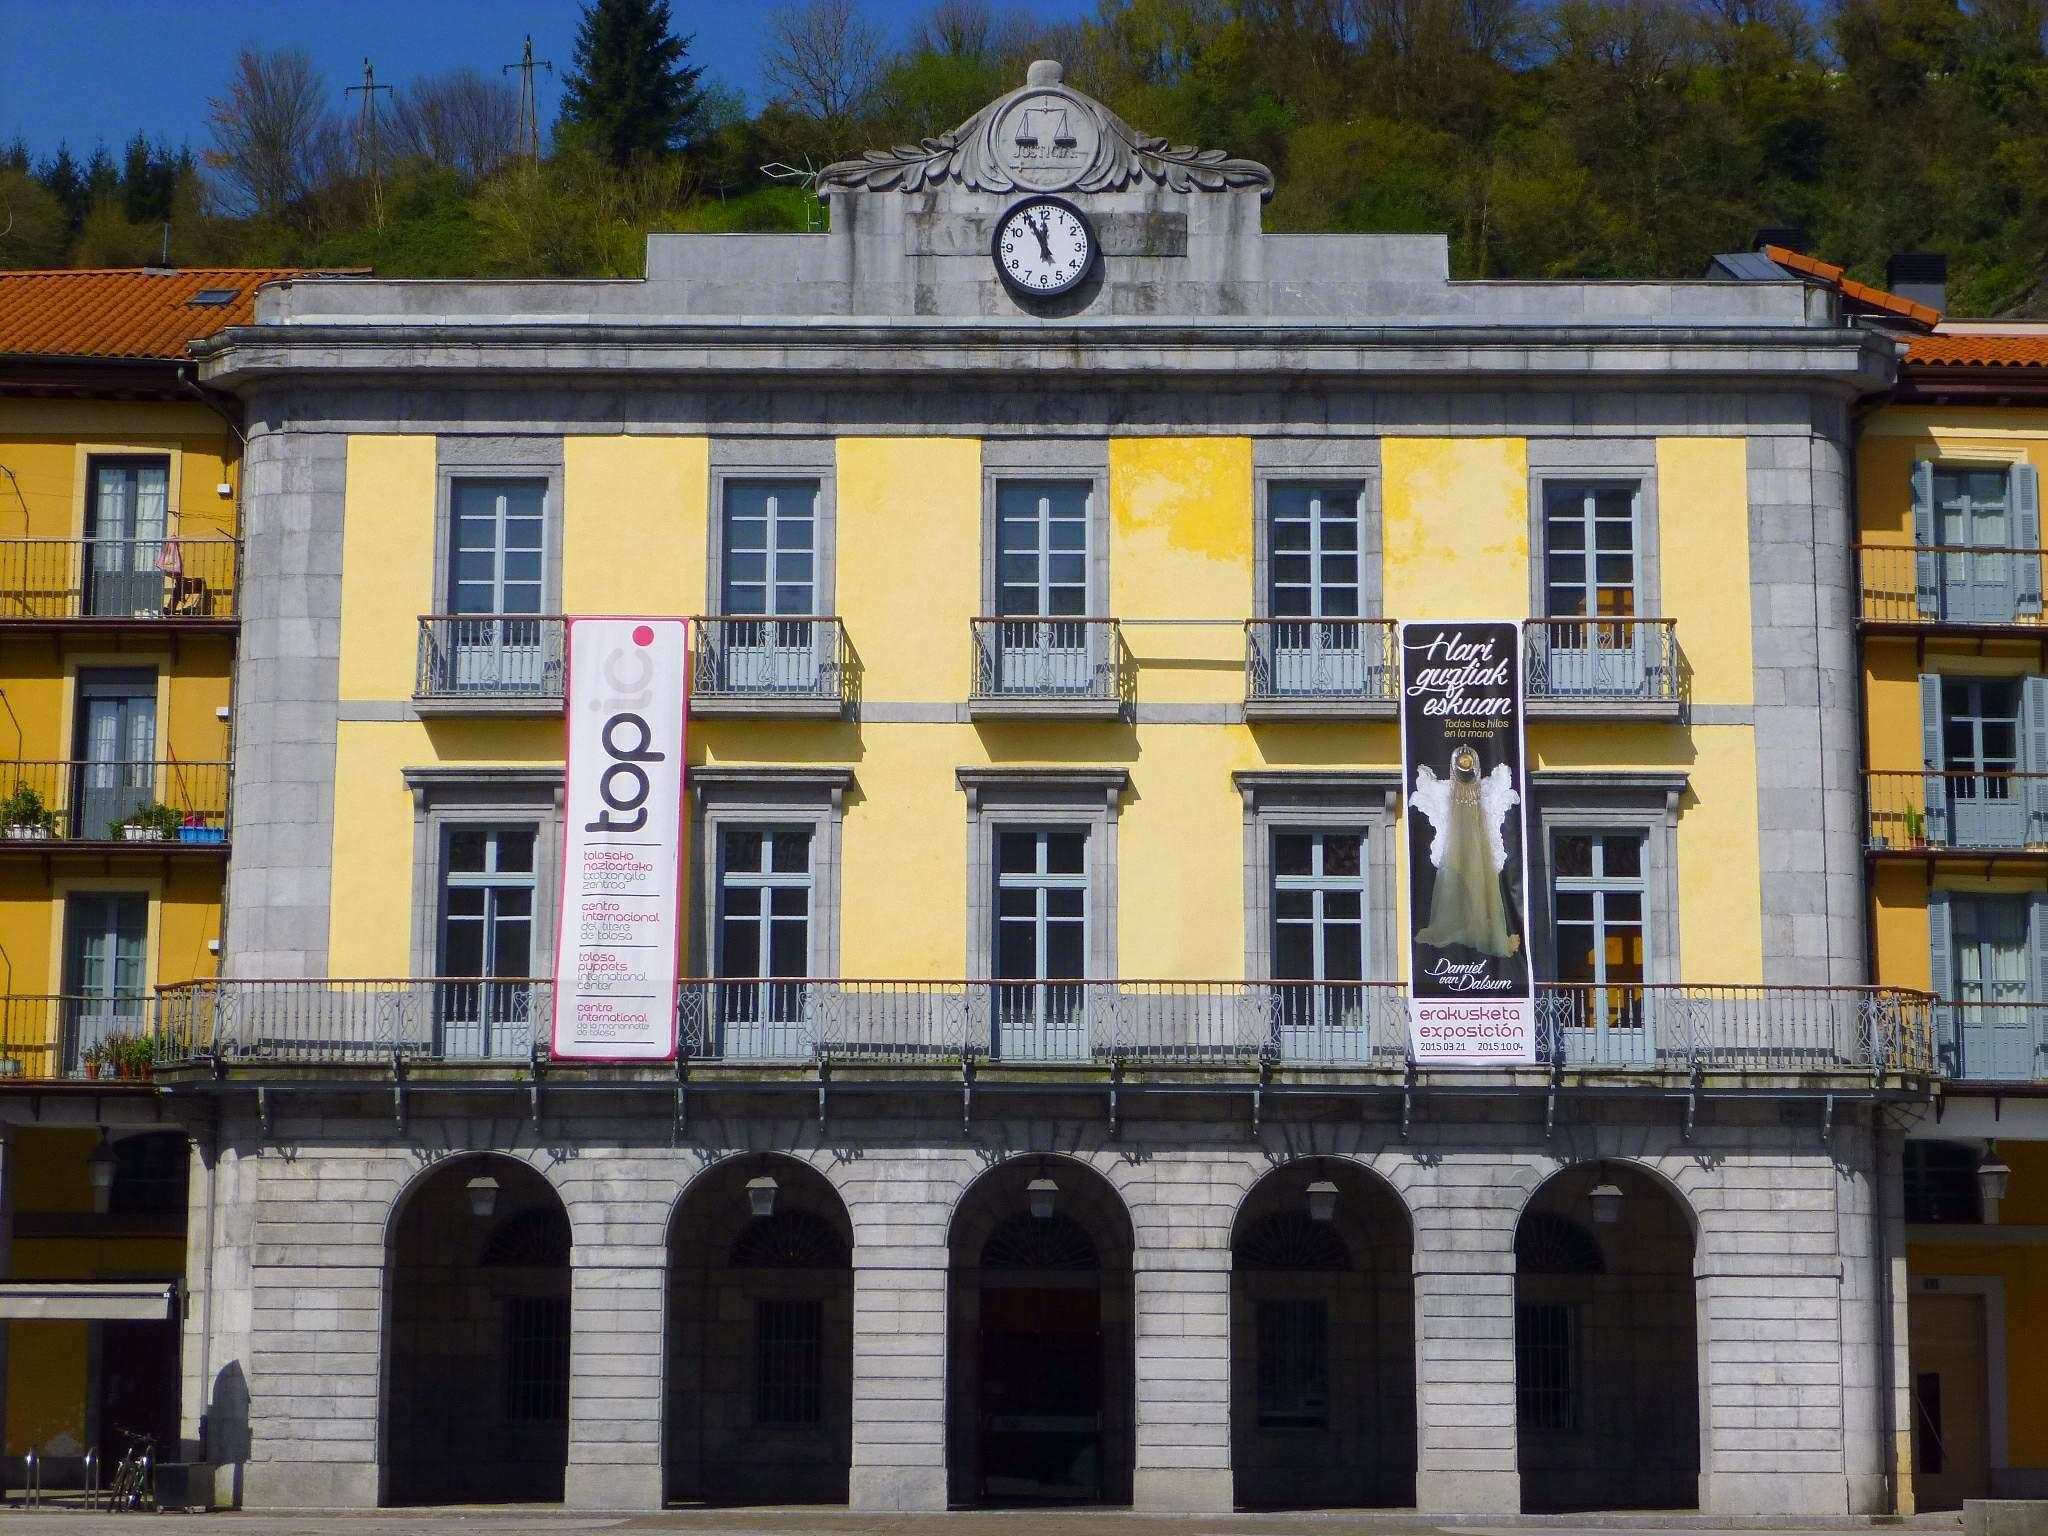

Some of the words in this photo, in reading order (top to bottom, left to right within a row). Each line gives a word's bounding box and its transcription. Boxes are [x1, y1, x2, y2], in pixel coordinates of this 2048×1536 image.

[1039, 210, 1051, 220] 12
[1058, 215, 1064, 225] 1
[1011, 228, 1023, 238] 10
[1070, 226, 1077, 236] 2
[1005, 243, 1014, 253] 9
[1074, 242, 1082, 253] 3
[1011, 259, 1020, 269] 8
[1069, 259, 1077, 269] 4
[1025, 270, 1033, 280] 7
[1040, 274, 1048, 285] 6
[1055, 271, 1063, 281] 5
[1403, 632, 1496, 661] Hari
[1407, 658, 1509, 698] guztiak
[1423, 688, 1512, 716] eskuan
[1444, 719, 1470, 728] Todos
[1472, 719, 1486, 728] los
[1487, 719, 1509, 728] hilos
[1444, 730, 1456, 738] en
[1457, 729, 1465, 738] la
[1467, 730, 1494, 738] mano
[583, 851, 634, 861] tolosako
[583, 861, 653, 872] nazioarteko
[582, 880, 626, 890] zentroa
[581, 901, 620, 911] centro
[582, 911, 660, 922] internacional
[580, 931, 594, 940] de
[597, 930, 632, 940] tolosa
[579, 952, 616, 962] tolosa
[578, 962, 628, 973] puppets
[577, 972, 648, 982] international
[1439, 976, 1459, 984] van
[1448, 973, 1512, 991] Dalsum
[577, 981, 613, 990] center
[577, 1003, 613, 1012] centre
[577, 1012, 648, 1023] international
[1419, 1006, 1520, 1021] erakusketa
[1419, 1022, 1524, 1041] exposición
